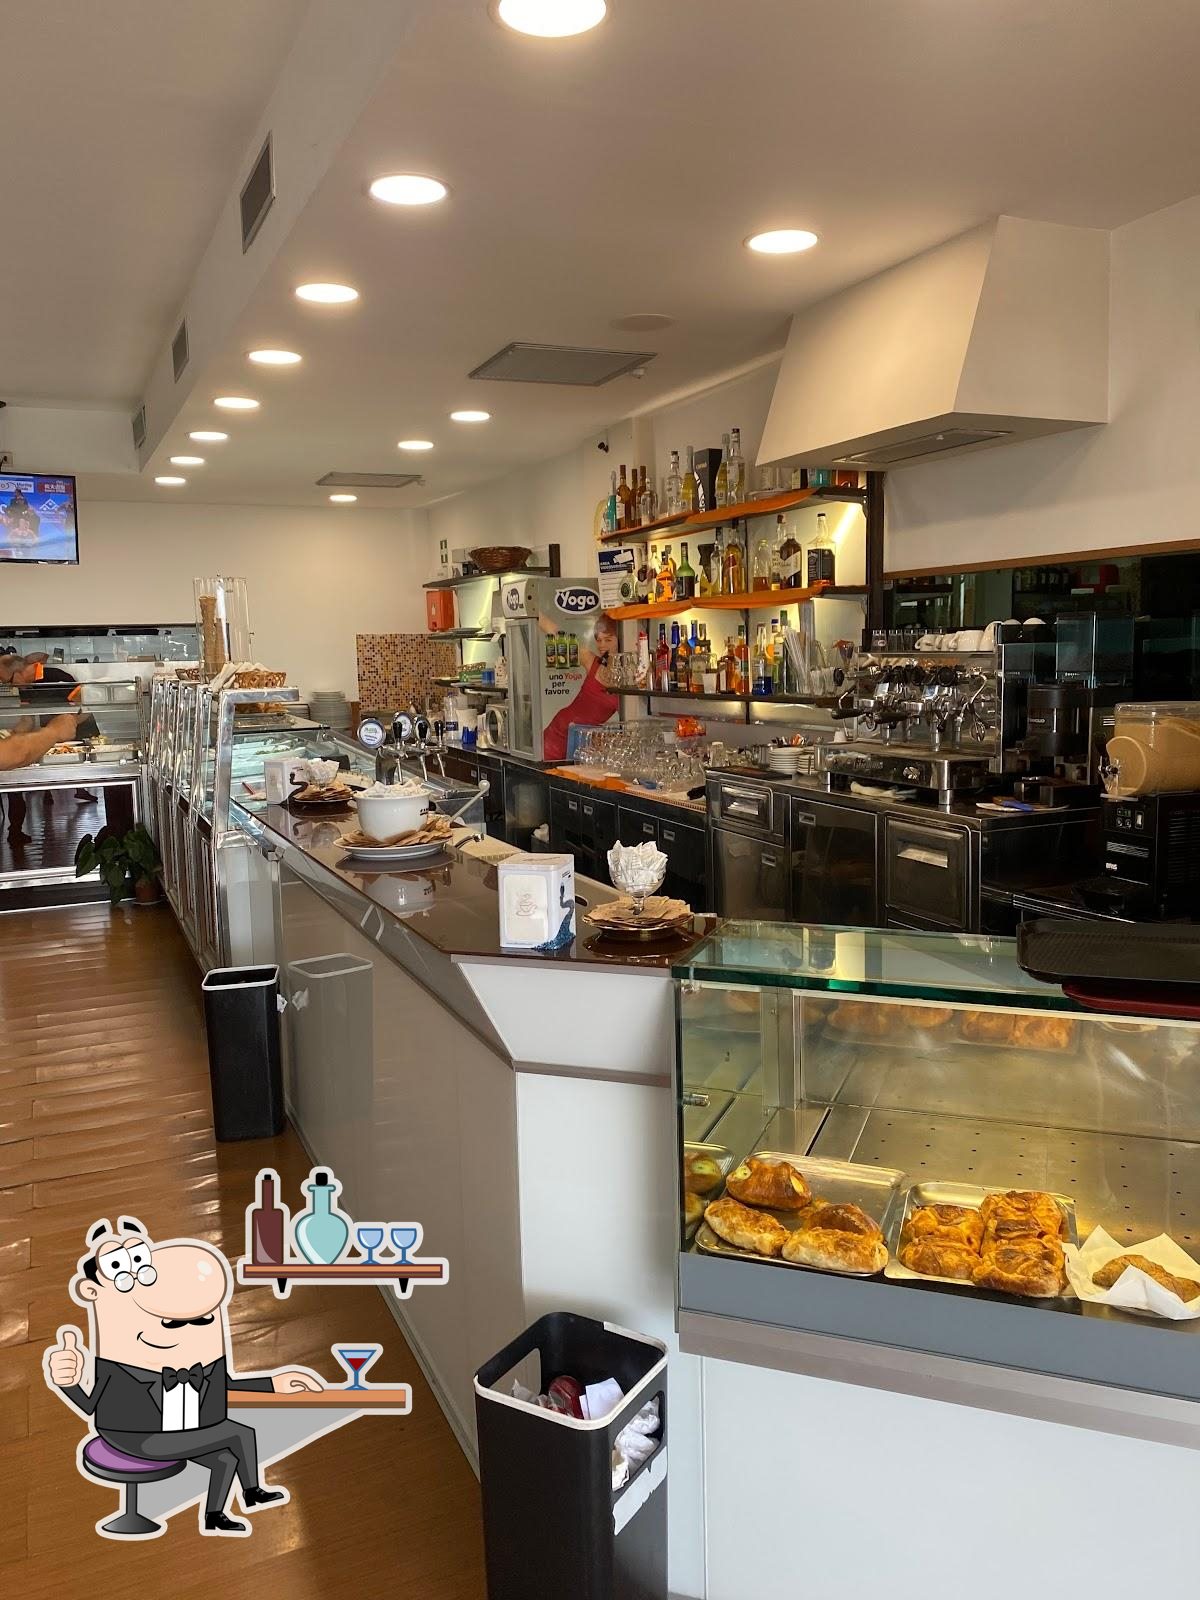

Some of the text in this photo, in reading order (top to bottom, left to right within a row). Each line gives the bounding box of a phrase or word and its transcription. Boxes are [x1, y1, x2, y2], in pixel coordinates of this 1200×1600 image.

[560, 590, 596, 610] Yoga
[564, 672, 583, 682] Yoga
[552, 681, 566, 689] per
